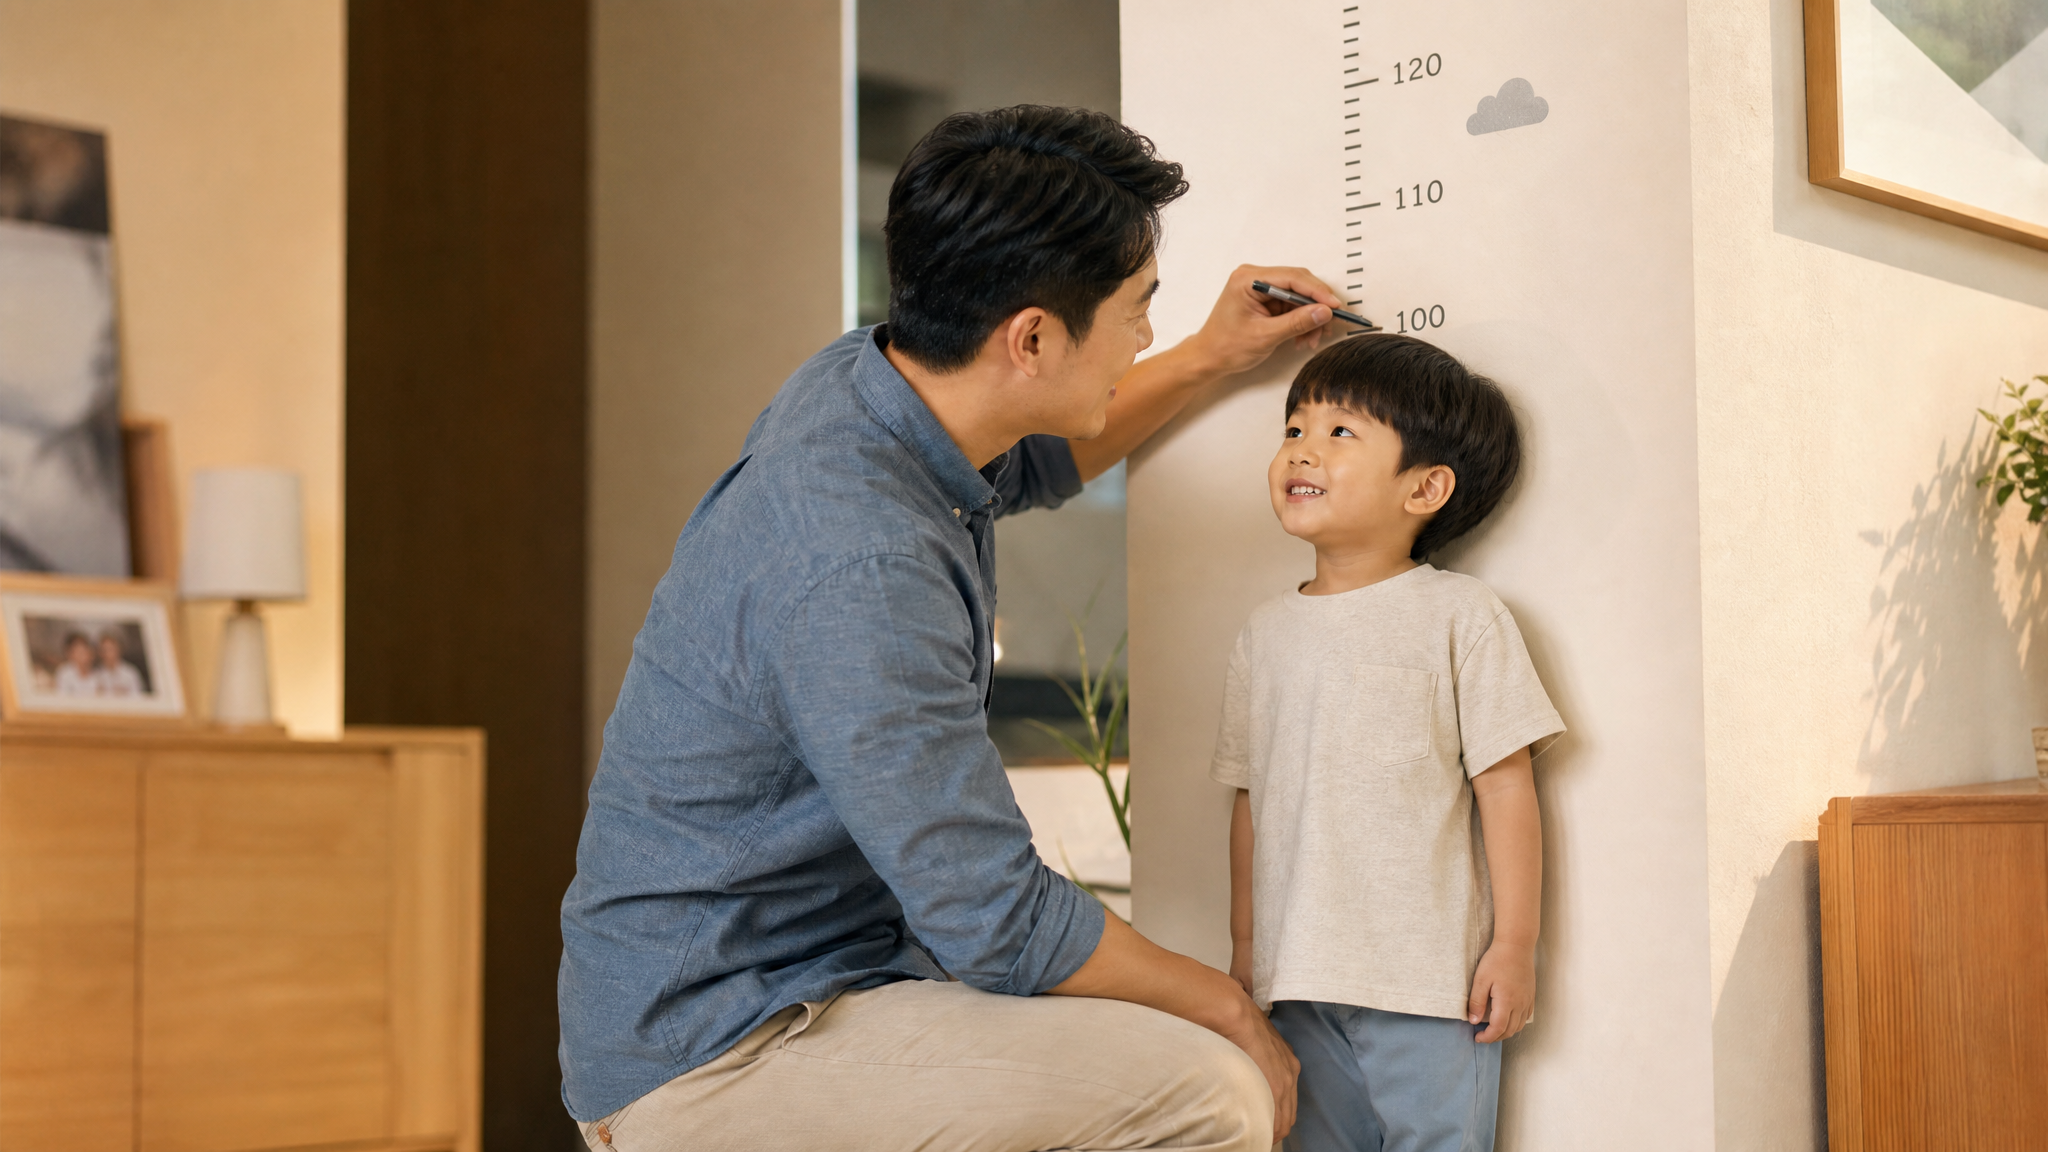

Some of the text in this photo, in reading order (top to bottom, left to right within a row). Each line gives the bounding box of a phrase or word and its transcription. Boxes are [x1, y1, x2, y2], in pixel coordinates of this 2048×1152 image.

[1393, 53, 1442, 84] 120
[1395, 180, 1444, 210] 110
[1397, 304, 1446, 334] 100
